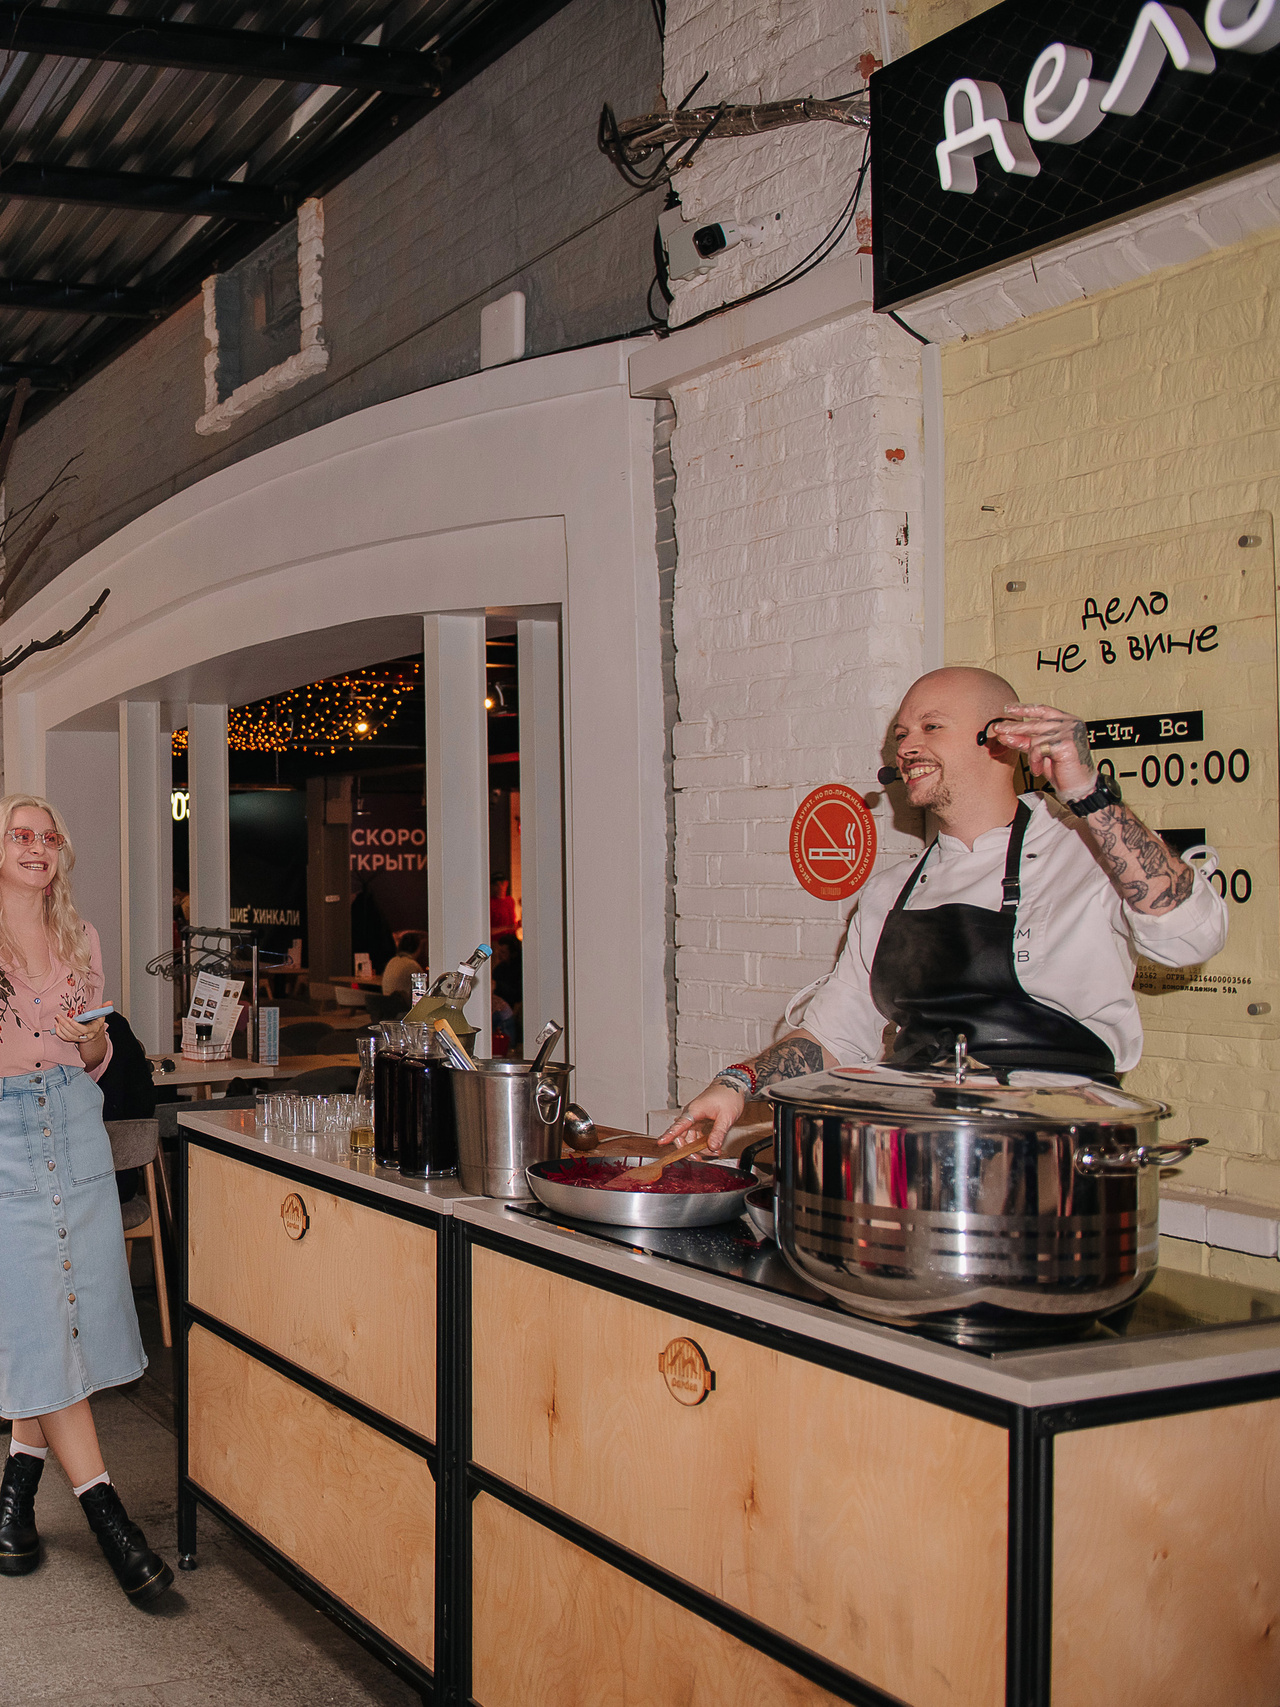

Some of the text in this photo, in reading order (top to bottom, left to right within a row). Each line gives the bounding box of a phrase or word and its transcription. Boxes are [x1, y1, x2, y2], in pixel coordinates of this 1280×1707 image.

[1087, 718, 1189, 743] н-Чт, Вс
[1097, 748, 1250, 788] 0-00:00
[351, 828, 426, 846] СКОРО
[349, 854, 427, 871] ТКРЫТИ
[253, 908, 300, 926] ХИНКАЛИ
[1135, 972, 1157, 980] 12562
[1166, 973, 1185, 981] ОГРН
